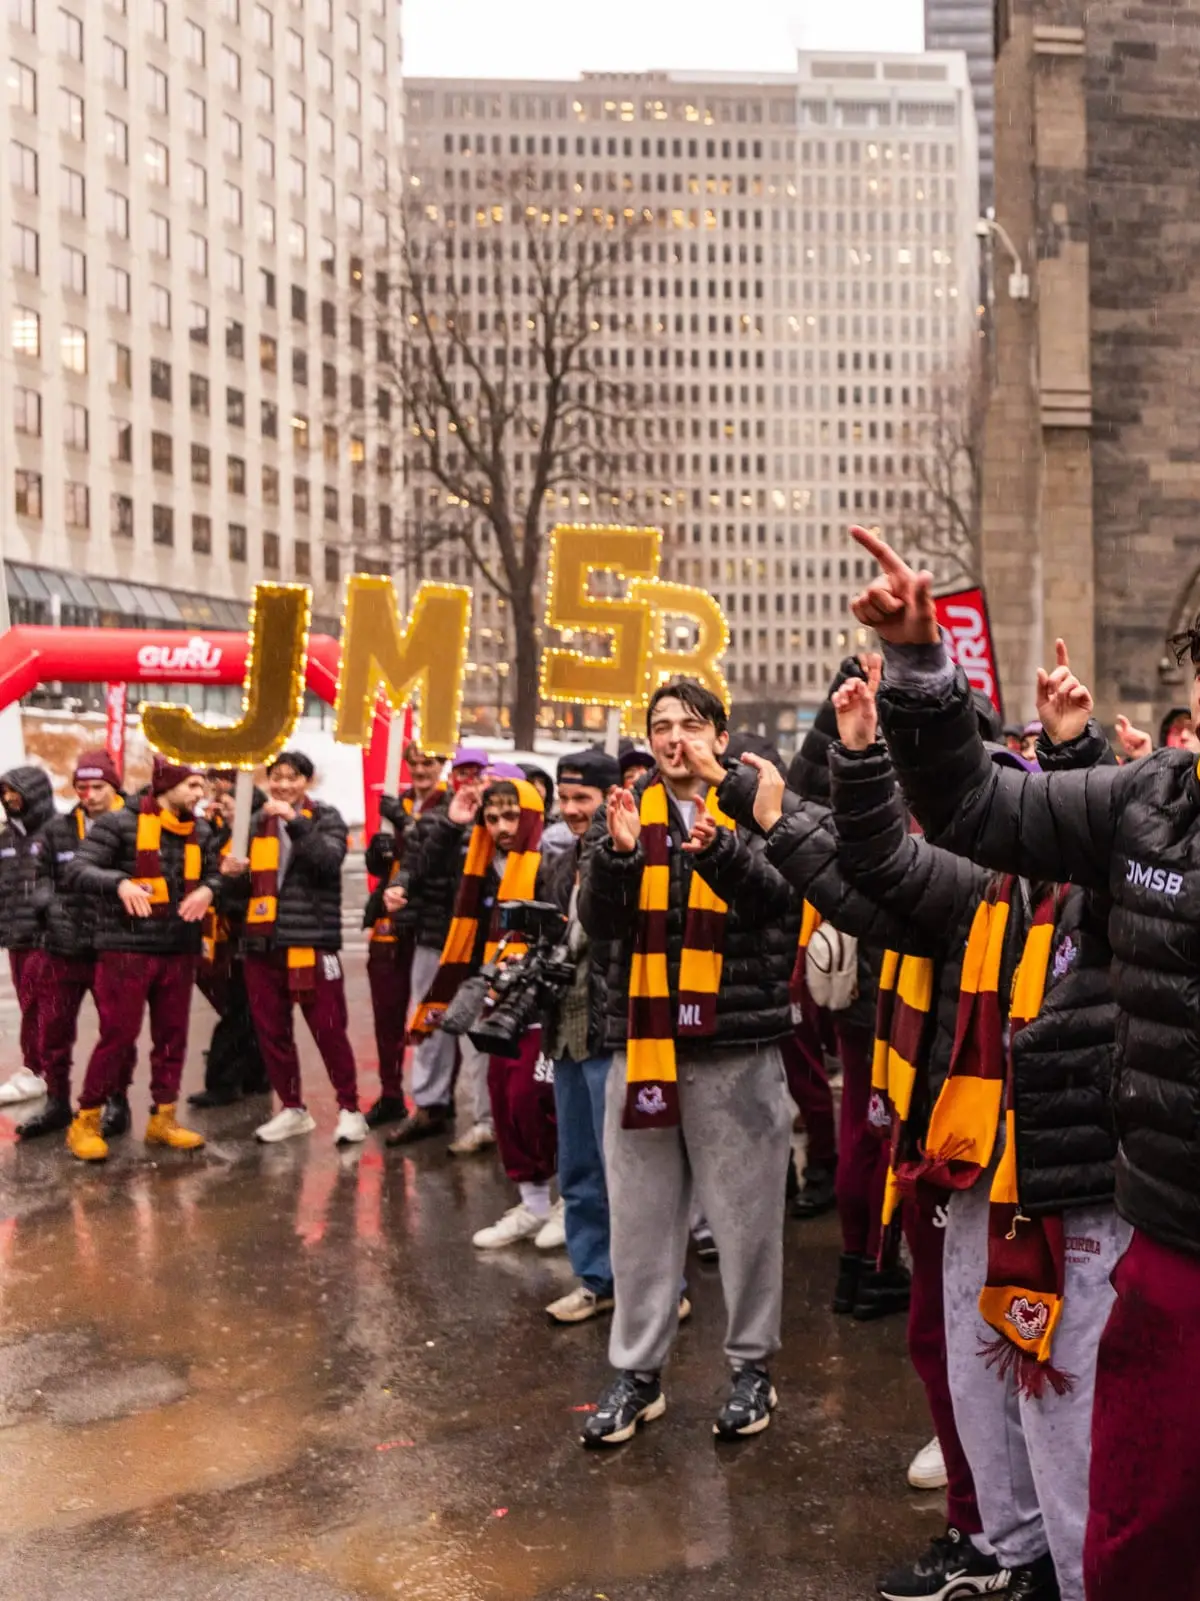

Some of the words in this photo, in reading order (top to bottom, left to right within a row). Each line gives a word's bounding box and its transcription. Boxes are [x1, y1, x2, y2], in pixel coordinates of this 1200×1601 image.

[137, 636, 223, 669] GURU
[944, 604, 993, 698] URU
[1125, 859, 1184, 896] JMSB
